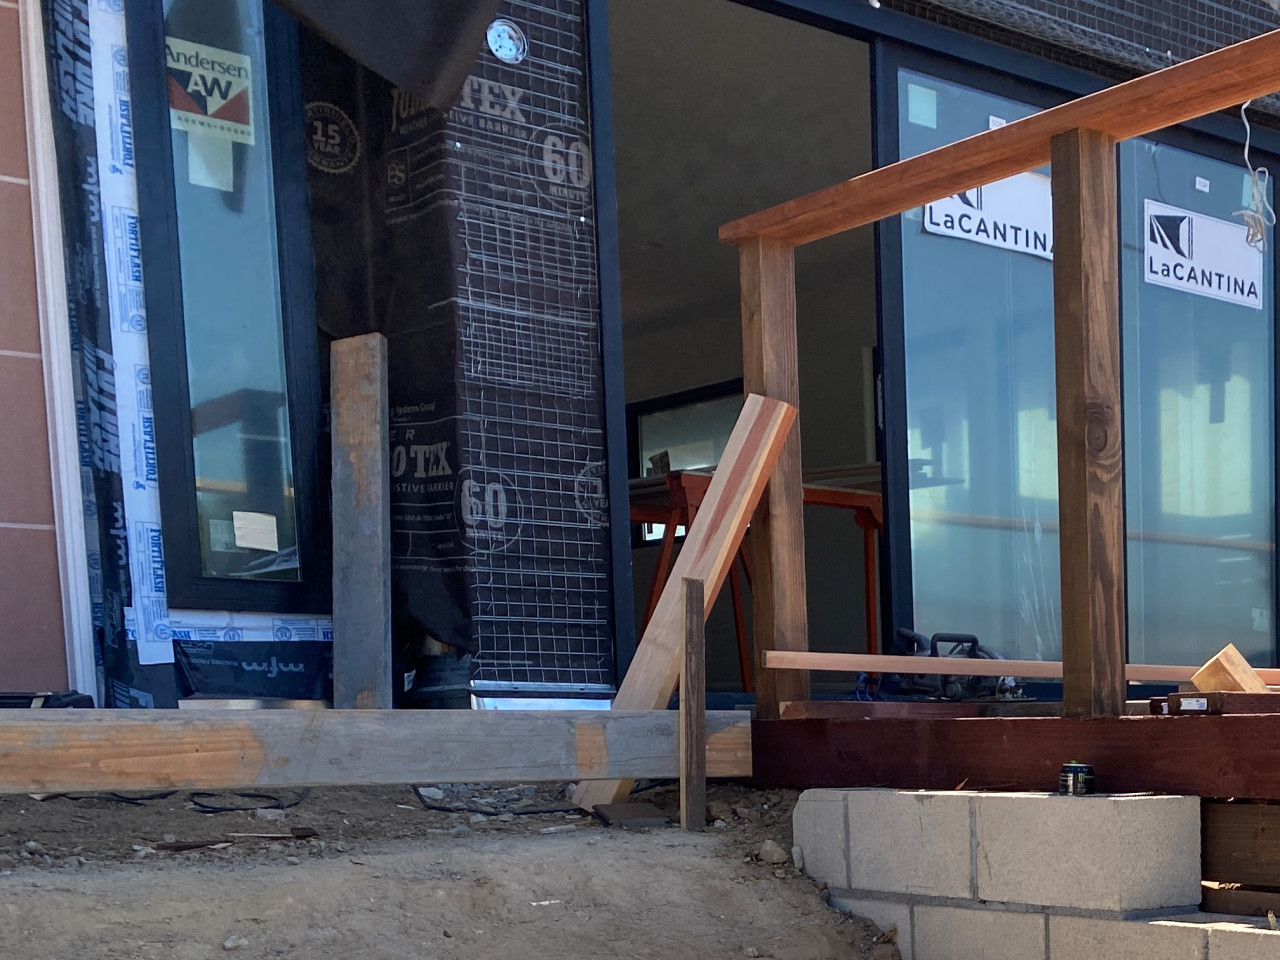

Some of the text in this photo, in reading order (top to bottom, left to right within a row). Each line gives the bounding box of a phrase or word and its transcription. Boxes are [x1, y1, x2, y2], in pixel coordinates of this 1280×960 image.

[165, 43, 248, 79] Andersen
[187, 72, 232, 101] AW
[313, 121, 341, 145] 15
[313, 140, 341, 155] YEAR
[543, 135, 592, 189] 60
[929, 205, 1053, 254] LaCANTIN
[1150, 256, 1258, 299] LaCANTINA
[461, 479, 507, 528] 60
[150, 528, 165, 594] FORTIFLASH
